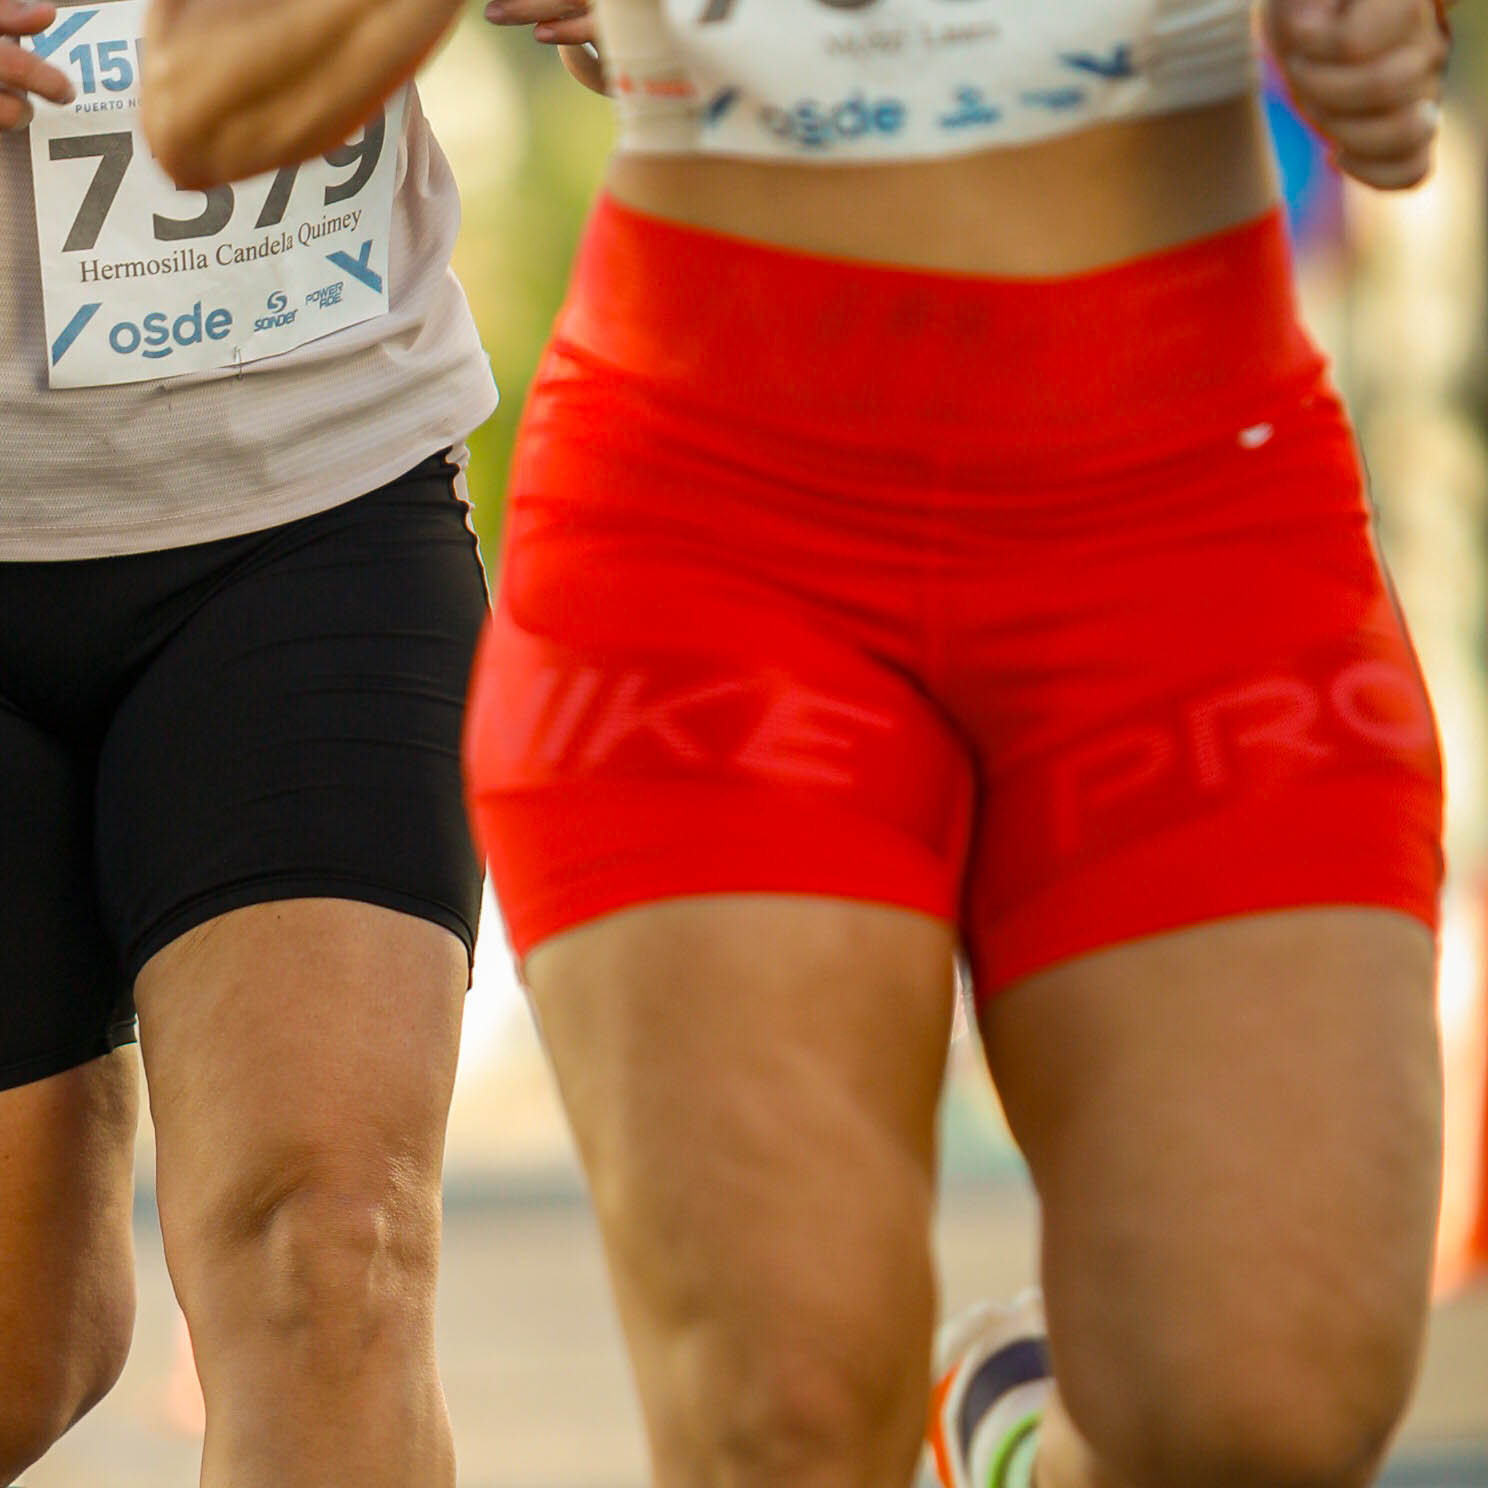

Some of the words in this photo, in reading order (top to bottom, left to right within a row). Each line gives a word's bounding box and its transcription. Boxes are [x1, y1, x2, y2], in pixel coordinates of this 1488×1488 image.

[69, 36, 145, 96] 15
[75, 100, 124, 113] PUERTO
[758, 90, 906, 148] osde
[79, 248, 209, 283] Hermosilla
[216, 228, 294, 266] Candela
[298, 209, 363, 250] Quimey
[305, 281, 344, 305] POWER
[109, 300, 233, 359] osde
